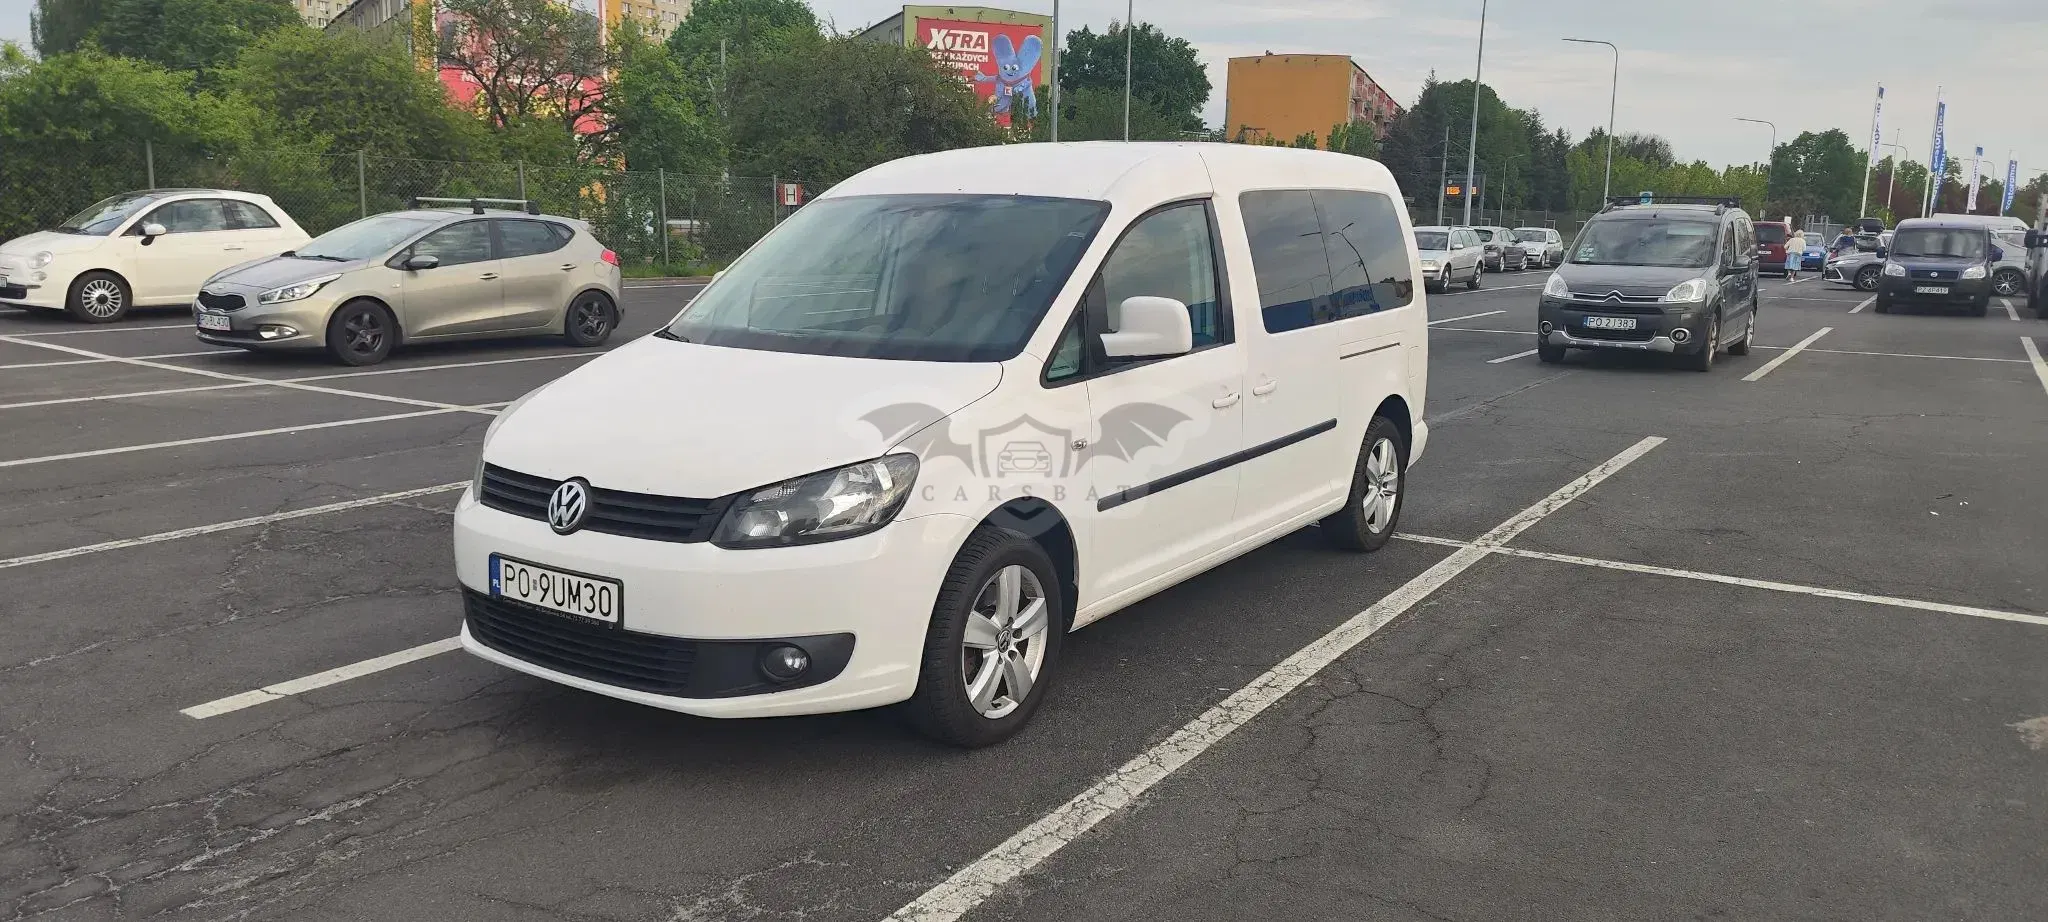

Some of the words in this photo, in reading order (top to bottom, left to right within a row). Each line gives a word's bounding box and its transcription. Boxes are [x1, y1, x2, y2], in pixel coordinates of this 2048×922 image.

[927, 28, 989, 53] XTRA
[949, 52, 989, 63] KAŻDYCH
[786, 188, 796, 203] H
[2005, 162, 2017, 210] castorama
[1588, 317, 1602, 326] PO
[1605, 318, 1635, 328] 2J383
[549, 481, 586, 529] VW
[492, 578, 501, 589] PL
[504, 563, 530, 598] PO
[539, 573, 612, 617] 9UM30
